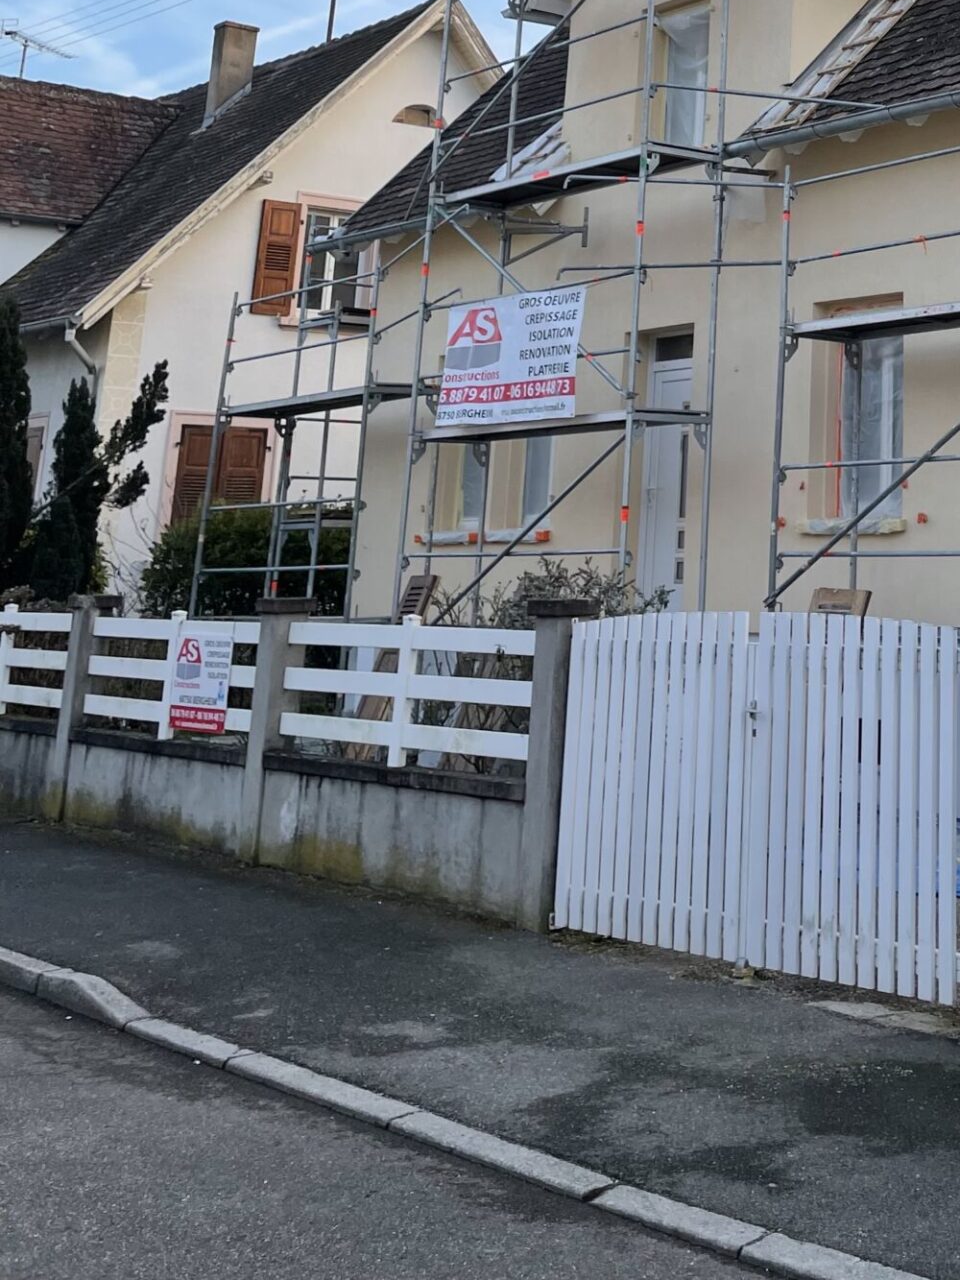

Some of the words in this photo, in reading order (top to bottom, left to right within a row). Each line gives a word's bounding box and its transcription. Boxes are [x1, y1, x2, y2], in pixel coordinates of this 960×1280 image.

[519, 297, 542, 309] GROS
[544, 292, 581, 306] OEUVRE
[525, 309, 578, 325] CREPISSAGE
[448, 307, 502, 346] AS
[529, 327, 574, 342] ISOLATION
[519, 344, 571, 360] RENOVATION
[528, 362, 569, 377] PLATRERIE
[177, 638, 202, 663] AS
